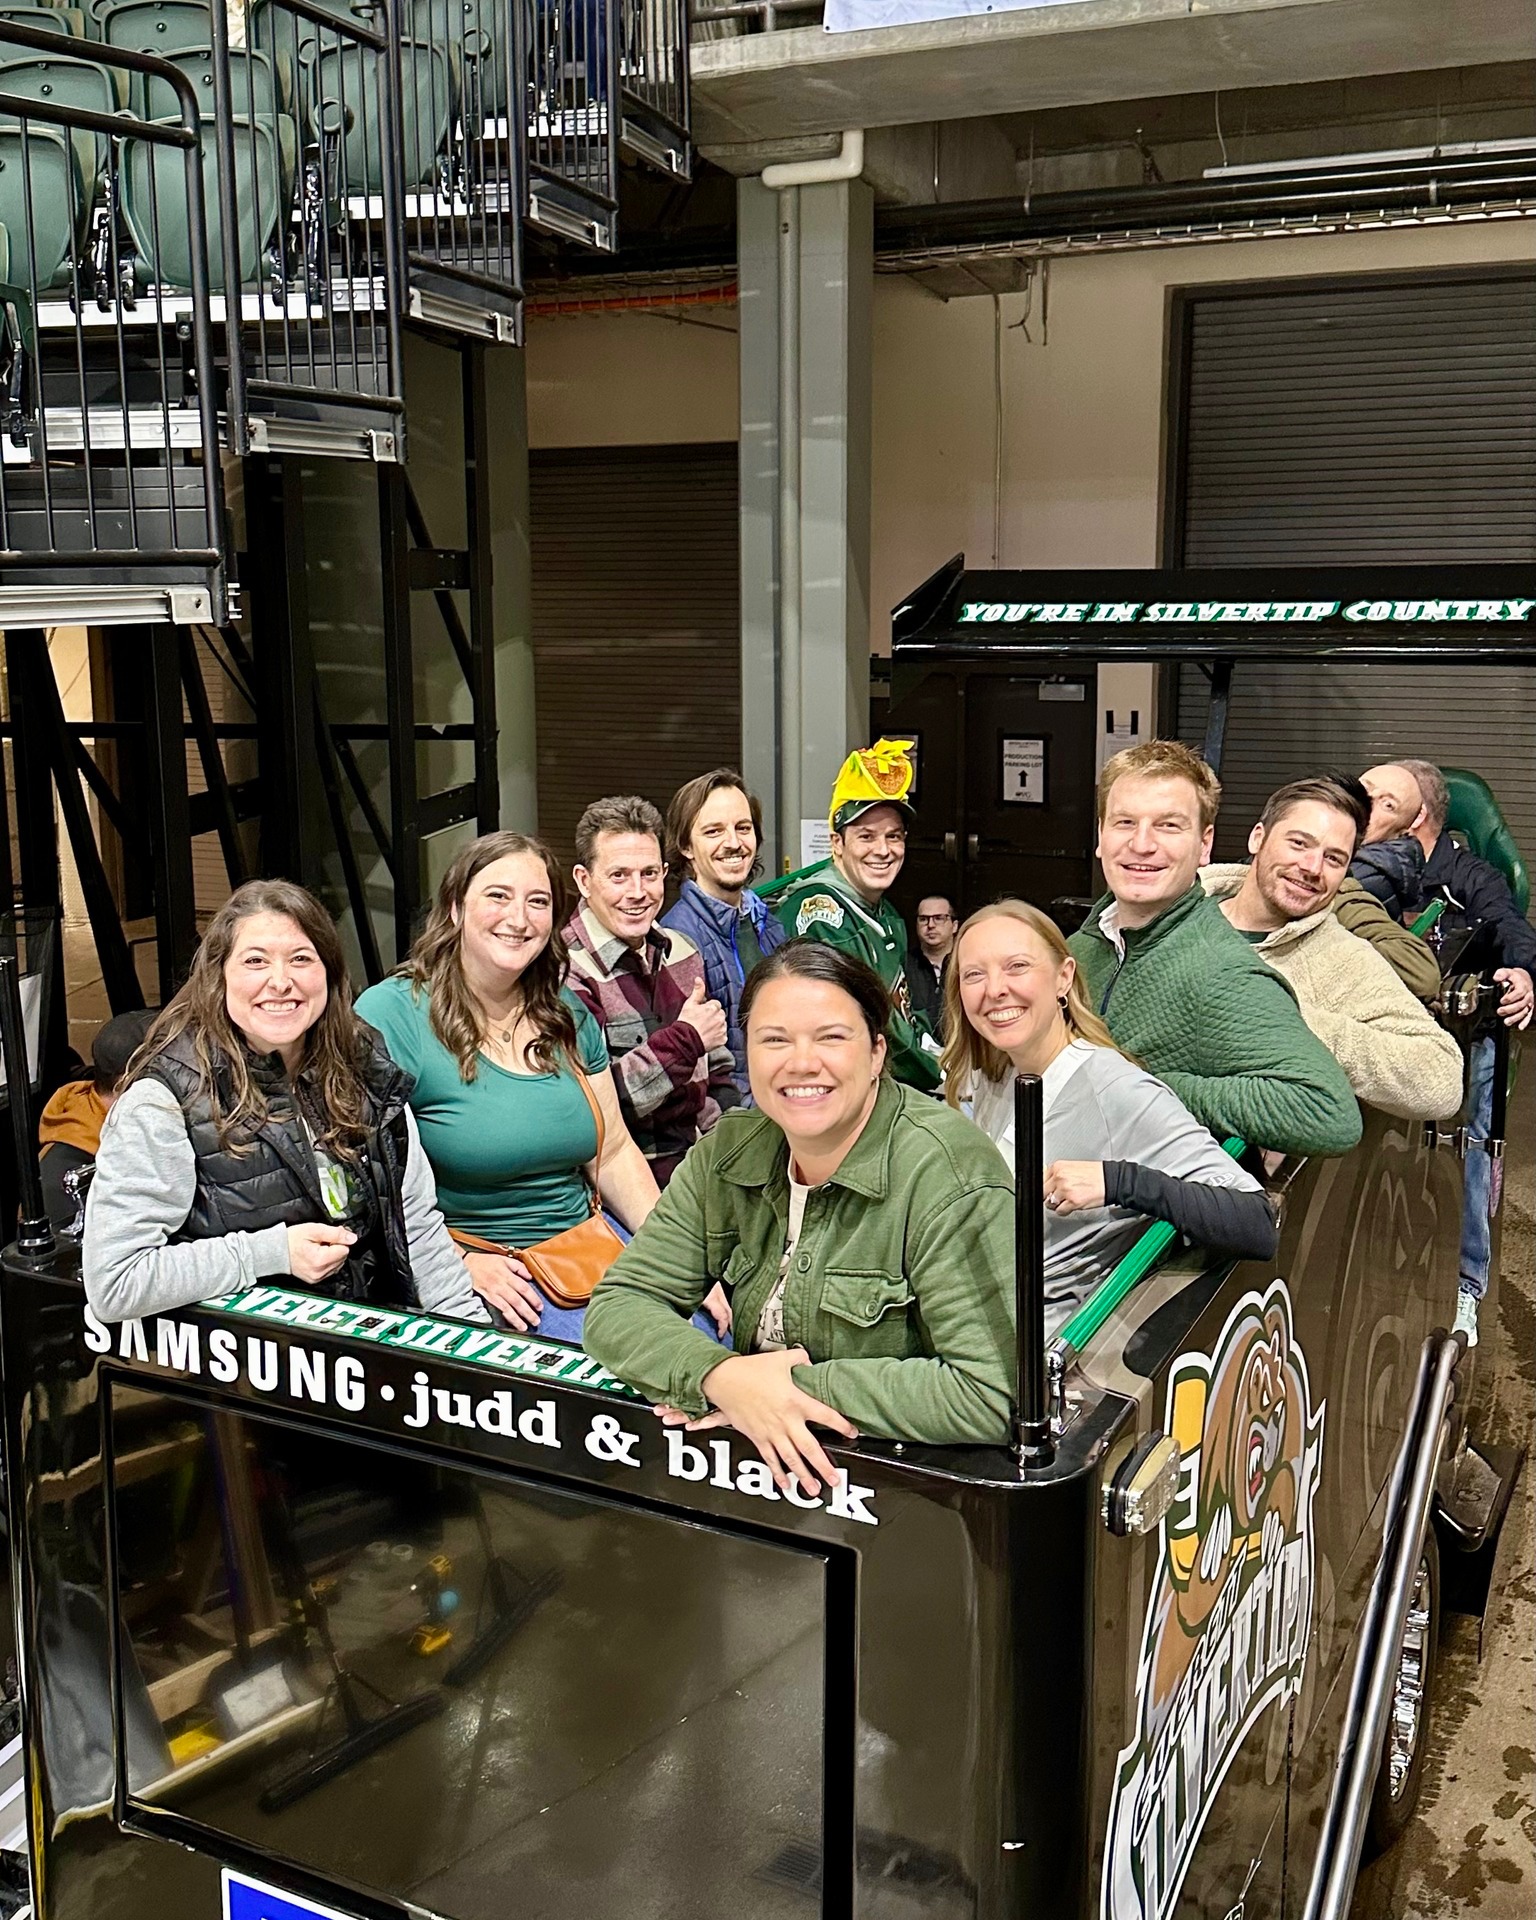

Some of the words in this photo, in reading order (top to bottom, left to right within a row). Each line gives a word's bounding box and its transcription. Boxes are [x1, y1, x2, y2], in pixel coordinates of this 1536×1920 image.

[959, 602, 1092, 623] YOU'RE
[1088, 602, 1145, 623] IN
[1140, 601, 1342, 623] SILVERTIP
[1342, 599, 1535, 622] COUNTRY
[84, 1303, 365, 1411] SAMSUNG
[403, 1371, 562, 1449] judd
[585, 1414, 641, 1468] &
[662, 1429, 879, 1526] black
